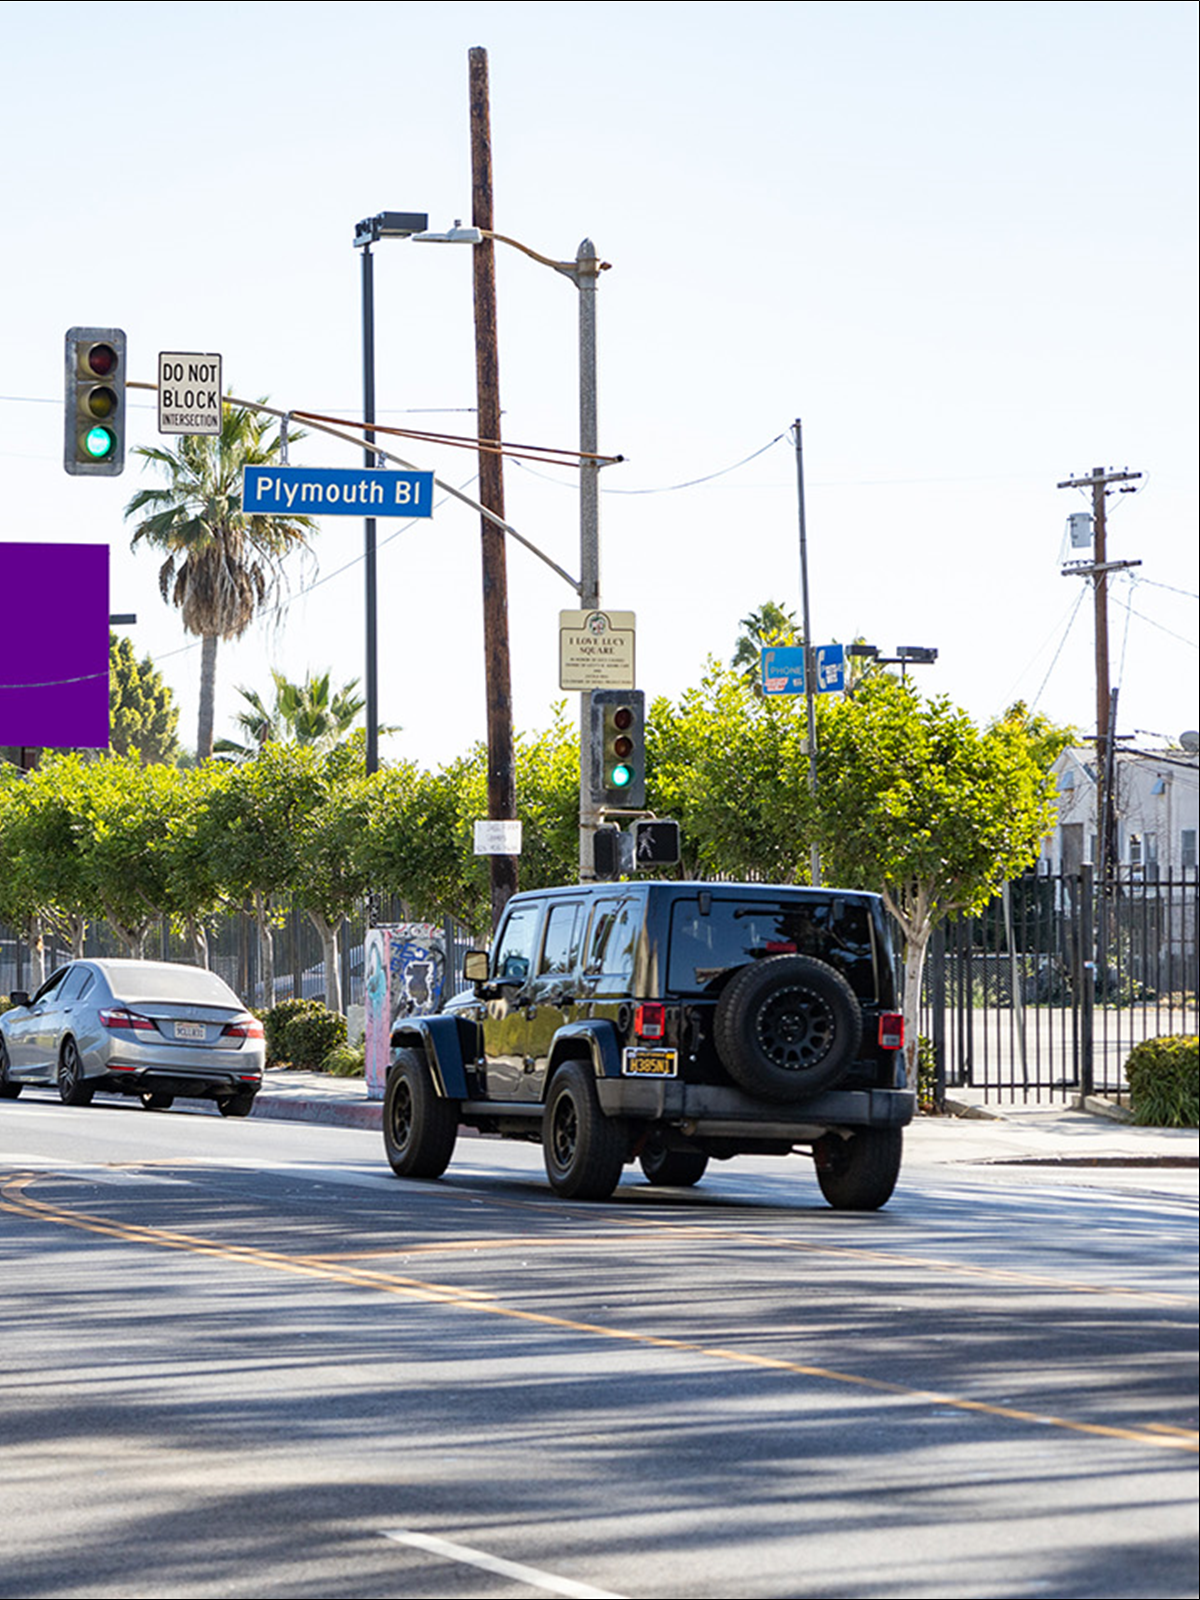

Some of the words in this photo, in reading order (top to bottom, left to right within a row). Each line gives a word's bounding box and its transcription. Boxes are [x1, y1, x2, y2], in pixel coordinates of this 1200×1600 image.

[163, 362, 184, 382] DO
[188, 363, 217, 383] NOT
[163, 389, 217, 409] BLOCK
[162, 413, 218, 427] INTERSECTION
[256, 476, 384, 508] Plymouth
[394, 480, 420, 505] Bl
[576, 637, 599, 645] LOVE
[602, 638, 625, 646] LUCY
[579, 647, 615, 656] SQUARE
[770, 665, 803, 675] PHONE
